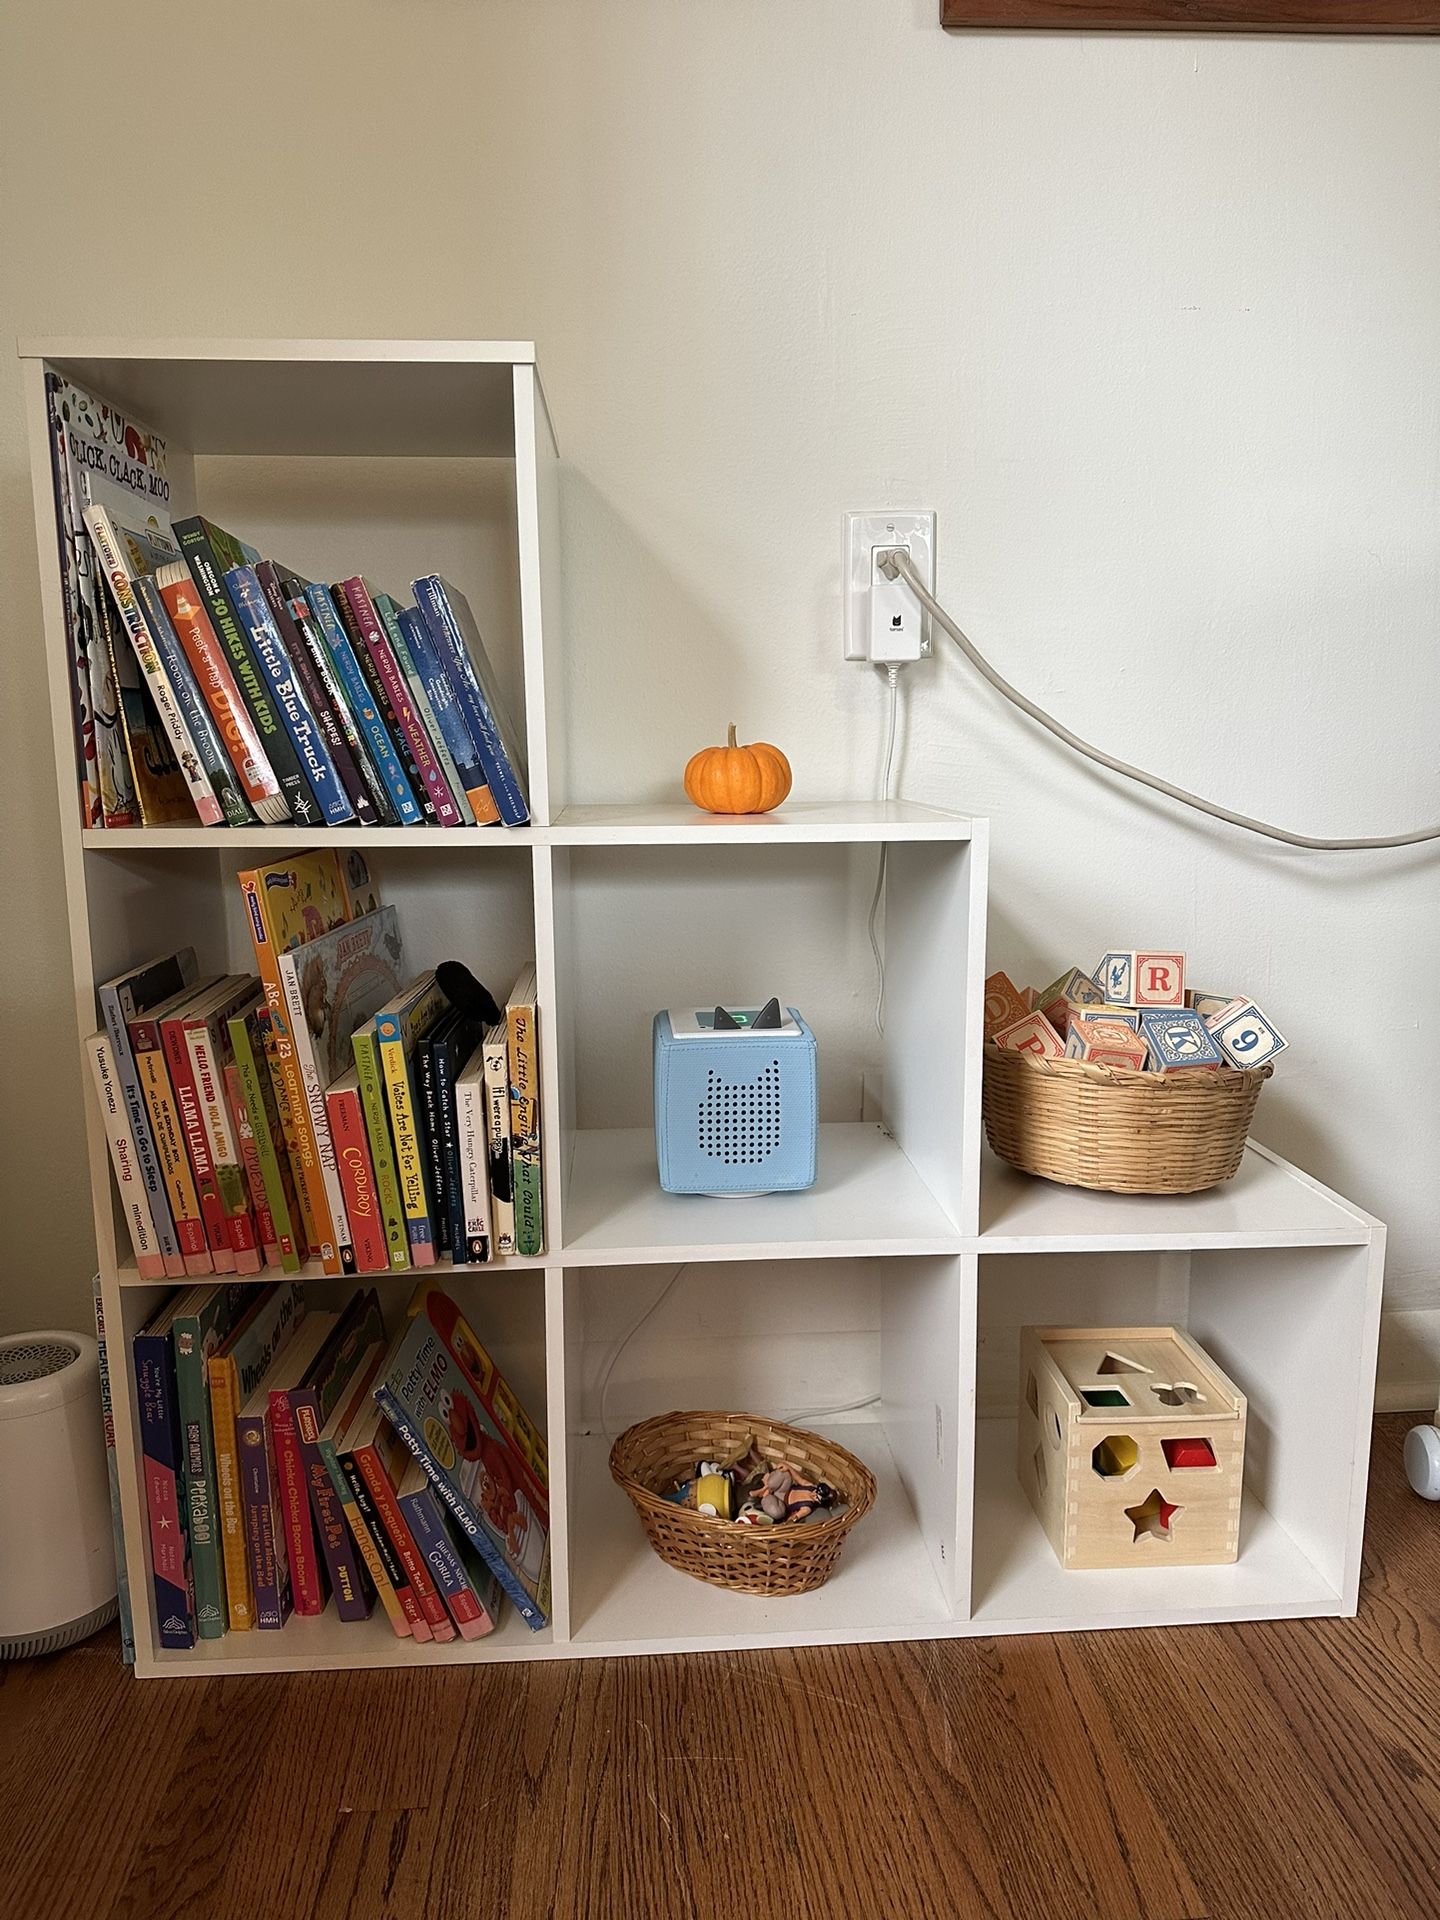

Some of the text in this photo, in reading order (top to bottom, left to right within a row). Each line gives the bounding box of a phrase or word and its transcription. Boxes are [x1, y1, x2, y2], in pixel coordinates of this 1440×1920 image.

[69, 432, 170, 501] CLICK, CLACK, MOO
[194, 555, 214, 597] WASHINGTON
[204, 561, 218, 587] OREGON
[426, 586, 440, 617] Tillman
[111, 571, 160, 674] CONSTRUCTION
[157, 685, 172, 712] Roger
[168, 712, 184, 741] Priddy
[220, 616, 246, 661] HIKES
[238, 660, 262, 699] WITH
[253, 698, 278, 735] KIDS
[351, 586, 431, 767] KASTNER NERDY BABIES WEATHER
[384, 611, 450, 766] Lost and Found Oliver Jeffers
[166, 654, 216, 766] Room on the Broom
[250, 624, 326, 782] Little Blue Truck
[320, 710, 342, 746] SHAPES!
[363, 653, 410, 758] NERDY BABIES SPACE
[370, 725, 390, 758] OCEAN
[226, 808, 244, 818] DIAL
[286, 970, 302, 1016] JAN BRETT
[1147, 966, 1172, 992] R
[264, 982, 314, 1168] ABC 123 Learning songs
[1167, 1030, 1200, 1051] K
[150, 1100, 161, 1122] CAJA
[168, 1030, 210, 1174] DEWDNEY LLAMA LLAMA
[201, 1072, 228, 1158] FRIEND AMIGO
[360, 1044, 393, 1205] KASTNER NERDY BABIES ROCKS
[392, 1080, 404, 1110] Voices
[396, 1114, 410, 1132] Are
[440, 1088, 449, 1112] Catch
[490, 1099, 502, 1153] were puppy
[515, 1018, 534, 1232] The Little Engine Could
[96, 1046, 148, 1250] Yusuke Yonezu Sharing minedition
[126, 1084, 158, 1193] It's Time to Go to Sleep
[160, 1100, 181, 1164] THE BIRTHDAY BOX
[303, 1064, 348, 1242] The SNOWY NAP PUTNAM
[400, 1133, 414, 1152] Not
[402, 1154, 414, 1171] for
[424, 1072, 432, 1088] Way
[434, 1164, 443, 1196] Jeffers
[464, 1092, 479, 1203] The Very Hungry Caterpillar
[338, 1100, 374, 1262] FREEMAN CORDUROY VIKING
[406, 1173, 420, 1210] Yelling
[96, 1297, 104, 1314] ERIC
[241, 1296, 293, 1394] Wheels the
[401, 1336, 436, 1402] Potty Time
[141, 1360, 157, 1424] Snuggle Bear
[414, 1394, 426, 1419] with
[422, 1352, 448, 1404] ELMO
[189, 1444, 202, 1474] ANIMALS
[220, 1453, 238, 1534] Wheels on the Bus
[398, 1424, 423, 1456] Potty
[418, 1452, 440, 1482] Time
[438, 1482, 456, 1507] with
[454, 1503, 478, 1536] ELMO
[250, 1504, 266, 1588] Jumping the Bed
[261, 1504, 275, 1586] Five Little Monkeys
[284, 1450, 306, 1586] Chicka Chicka Boom Boom
[310, 1464, 354, 1602] My First Pet DUTTON
[360, 1454, 416, 1572] Grande pequeño Britta
[410, 1498, 432, 1534] Rathmann
[352, 1516, 389, 1588] Hands On!
[428, 1550, 454, 1588] GORILA
[435, 1539, 456, 1567] BUENAS
[404, 1598, 418, 1618] tiger
